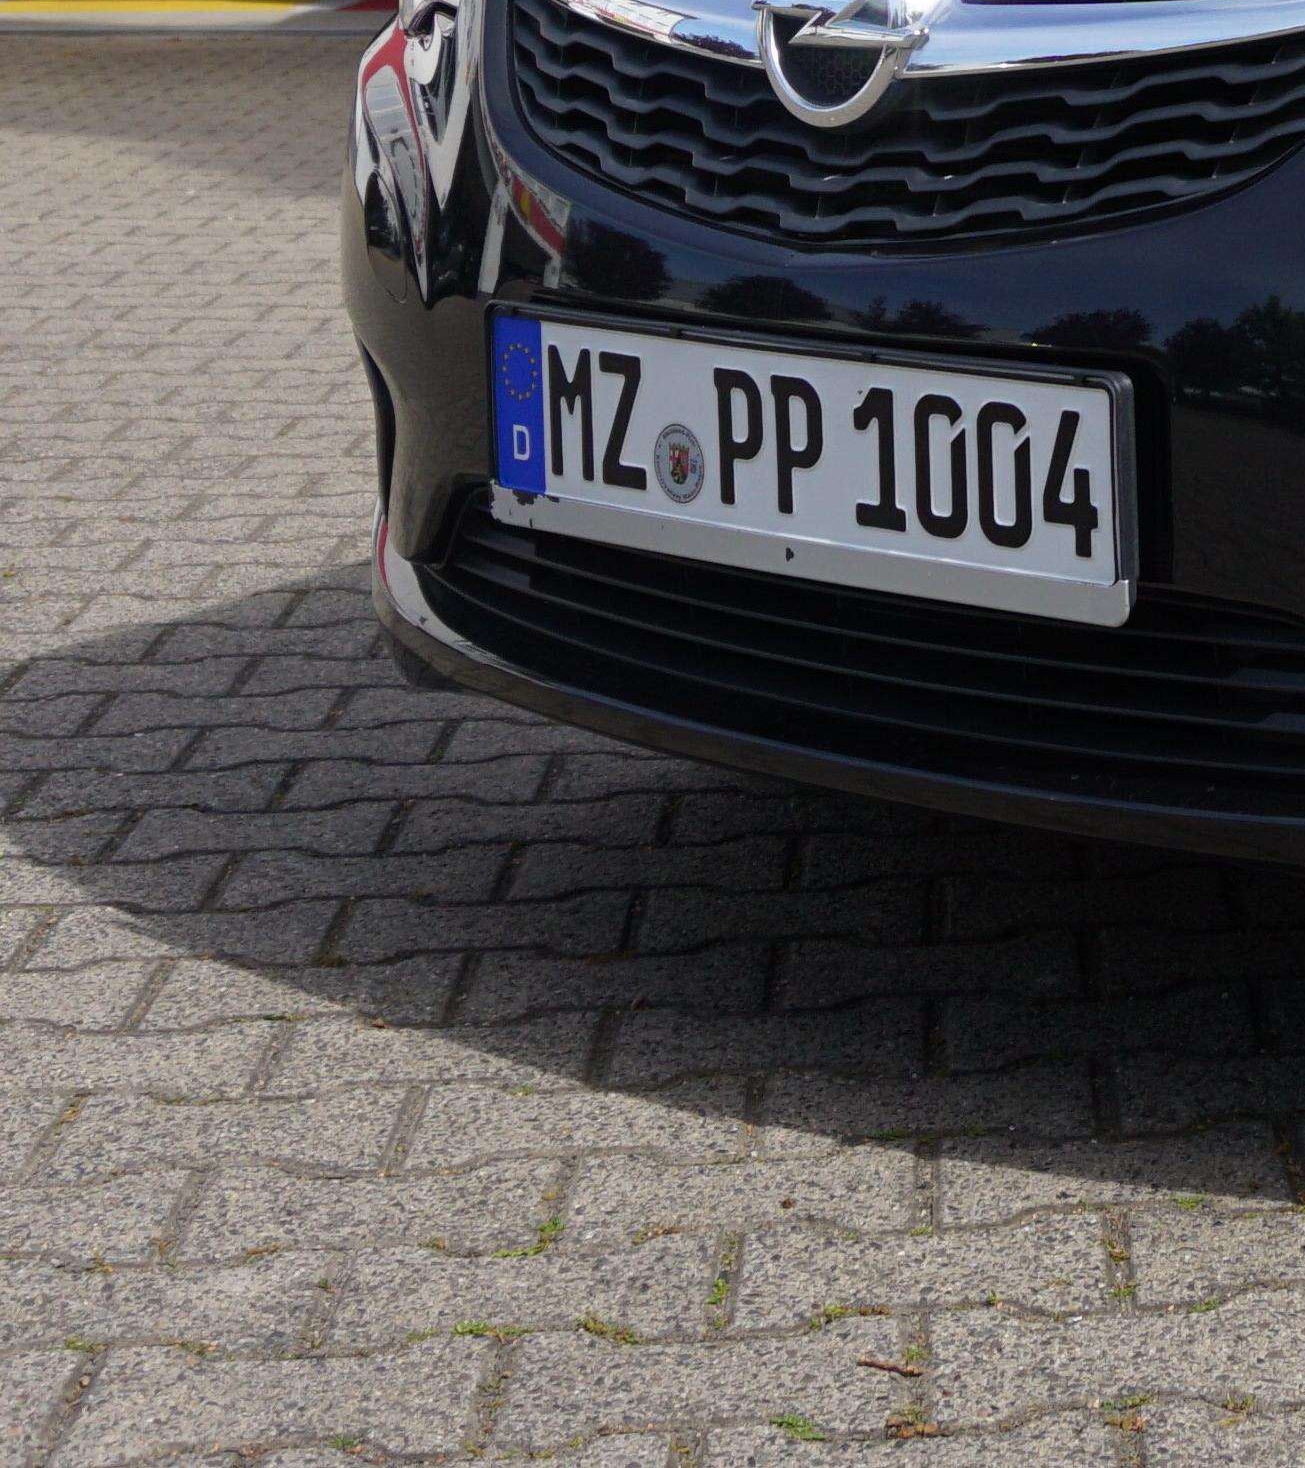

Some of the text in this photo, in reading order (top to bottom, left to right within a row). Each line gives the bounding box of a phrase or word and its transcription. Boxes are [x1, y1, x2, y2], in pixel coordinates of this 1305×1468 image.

[512, 424, 530, 461] D
[547, 343, 647, 491] MZ
[713, 367, 823, 515] PP
[853, 386, 1099, 559] 1004
